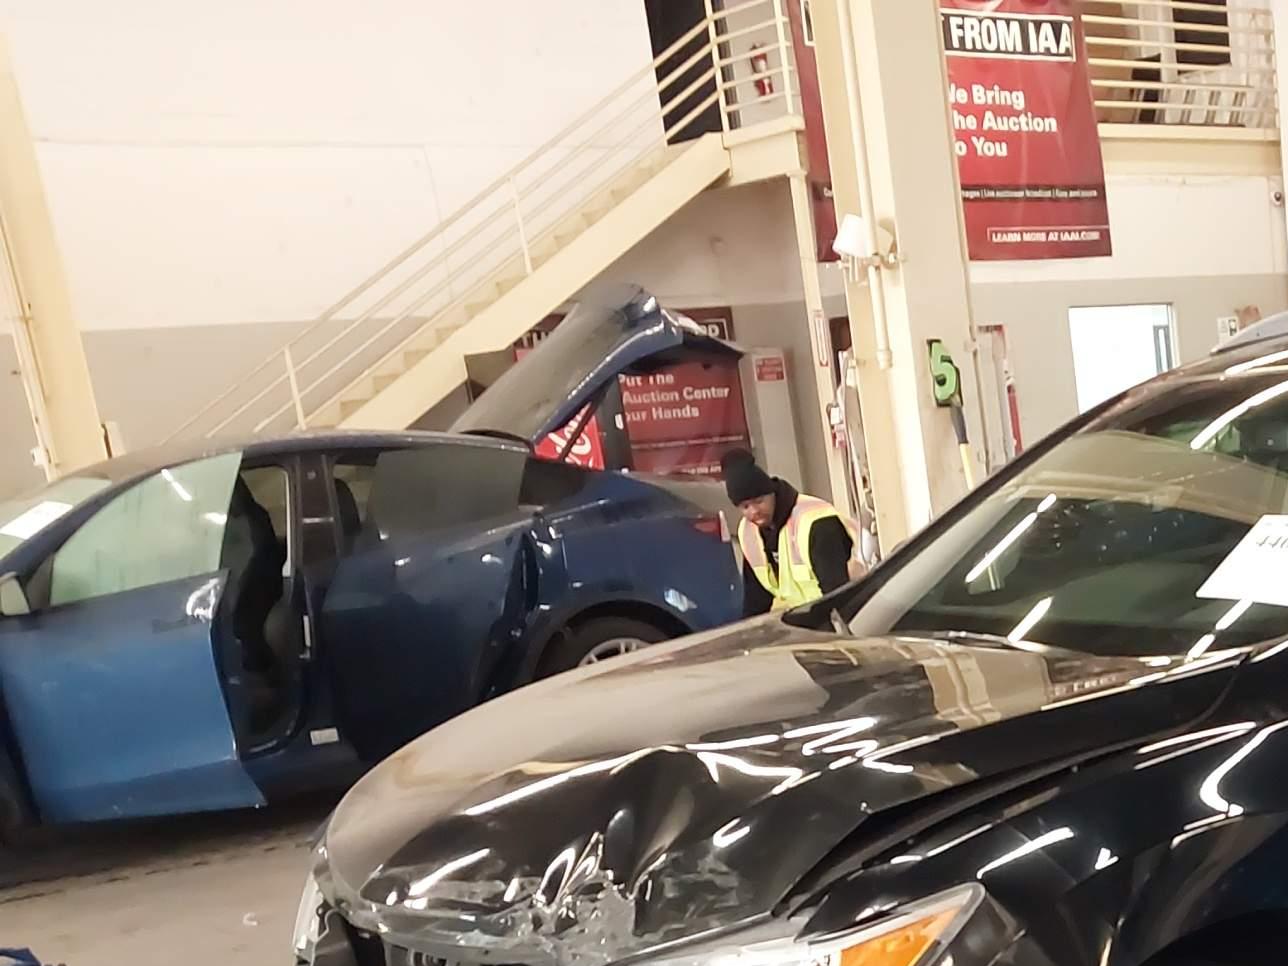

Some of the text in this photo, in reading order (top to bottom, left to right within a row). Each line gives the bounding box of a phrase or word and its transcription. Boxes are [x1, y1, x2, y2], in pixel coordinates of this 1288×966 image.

[950, 16, 1072, 54] FROM IAA
[972, 84, 1025, 110] Bring
[953, 109, 1057, 132] he Auction
[971, 135, 1008, 157] You
[1048, 231, 1059, 241] AT
[1060, 230, 1100, 241] IAAI.C
[618, 374, 642, 387] Put
[623, 386, 730, 405] Auction Center
[626, 404, 700, 422] our Hands
